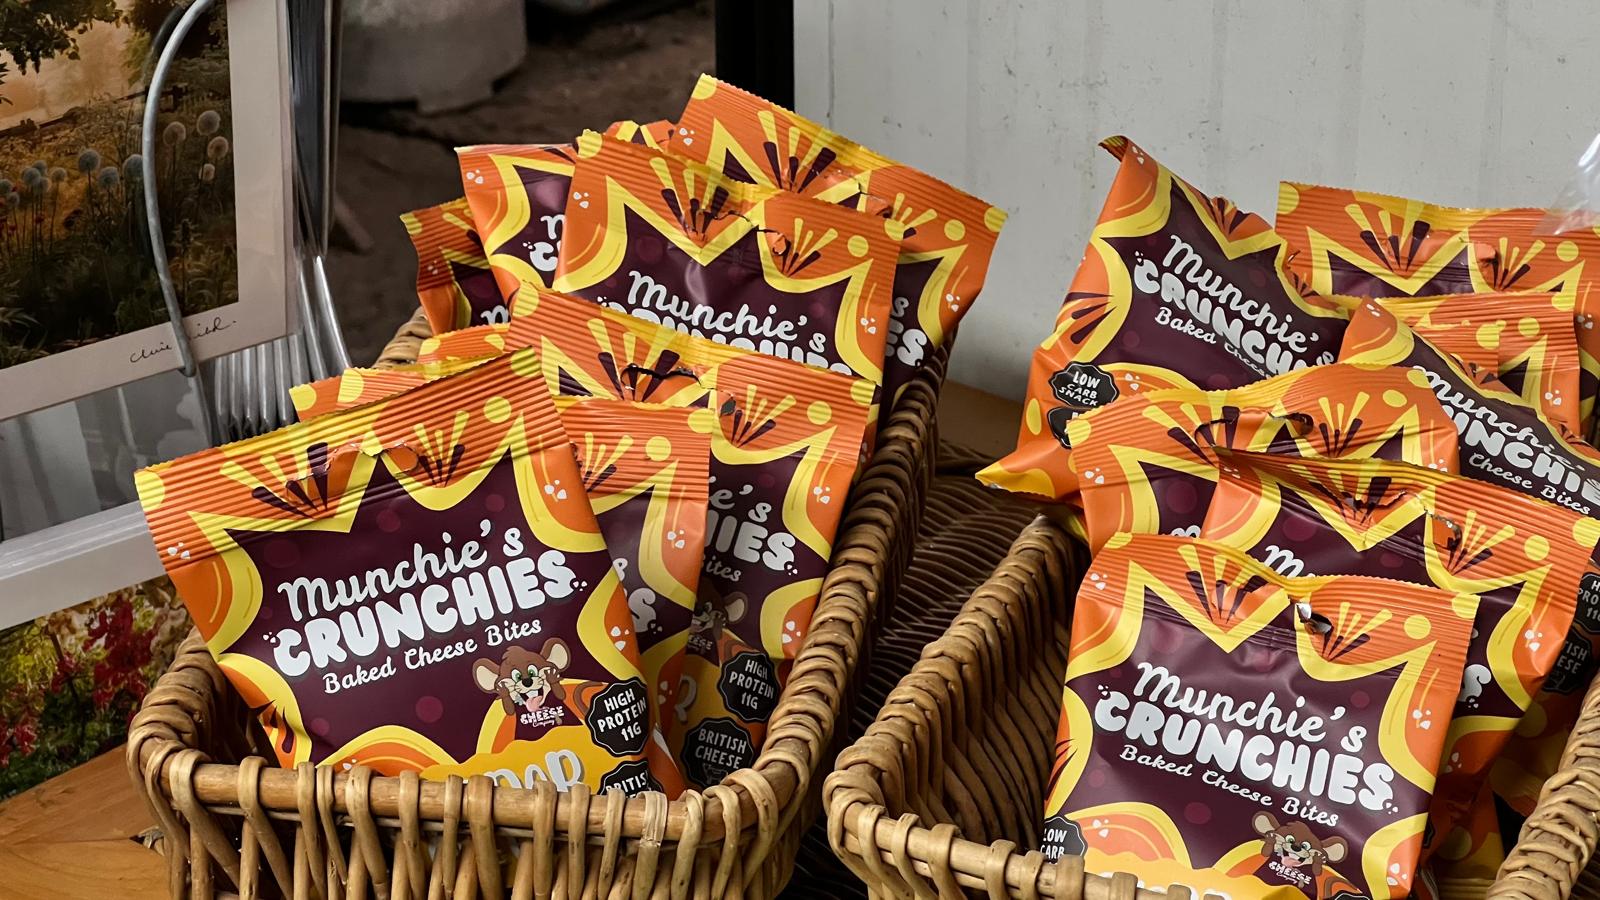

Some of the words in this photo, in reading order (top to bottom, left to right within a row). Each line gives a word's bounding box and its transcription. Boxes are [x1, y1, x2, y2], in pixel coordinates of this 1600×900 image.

[628, 269, 827, 353] Munchie's
[1133, 258, 1307, 375] CRUNCH
[1154, 306, 1217, 345] Baked
[1066, 383, 1098, 399] CARB
[1072, 370, 1101, 389] LOW
[1058, 386, 1099, 406] SNACK
[1468, 452, 1533, 489] Cheese
[1540, 484, 1591, 515] Bites
[277, 519, 524, 622] Munchie's
[703, 555, 742, 582] ites
[272, 550, 577, 677] CRUNCHIES
[322, 655, 397, 694] Baked
[403, 638, 478, 671] Cheese
[484, 618, 543, 647] Bites
[744, 659, 768, 680] HIGH
[728, 671, 774, 699] PROTEIN
[603, 688, 636, 713] HIGH
[741, 692, 759, 710] 11G
[1133, 661, 1368, 753] Munchie's
[519, 705, 565, 725] CHEESE
[597, 696, 647, 733] PROTEIN
[621, 721, 642, 741] 11G
[697, 728, 748, 755] BRITISH
[694, 745, 743, 770] CHEESE
[1094, 691, 1395, 811] CRUNCHIES
[605, 771, 649, 793] ITIS
[1118, 743, 1192, 777] Baked
[1201, 769, 1273, 807] Cheese
[1281, 796, 1340, 828] Bites
